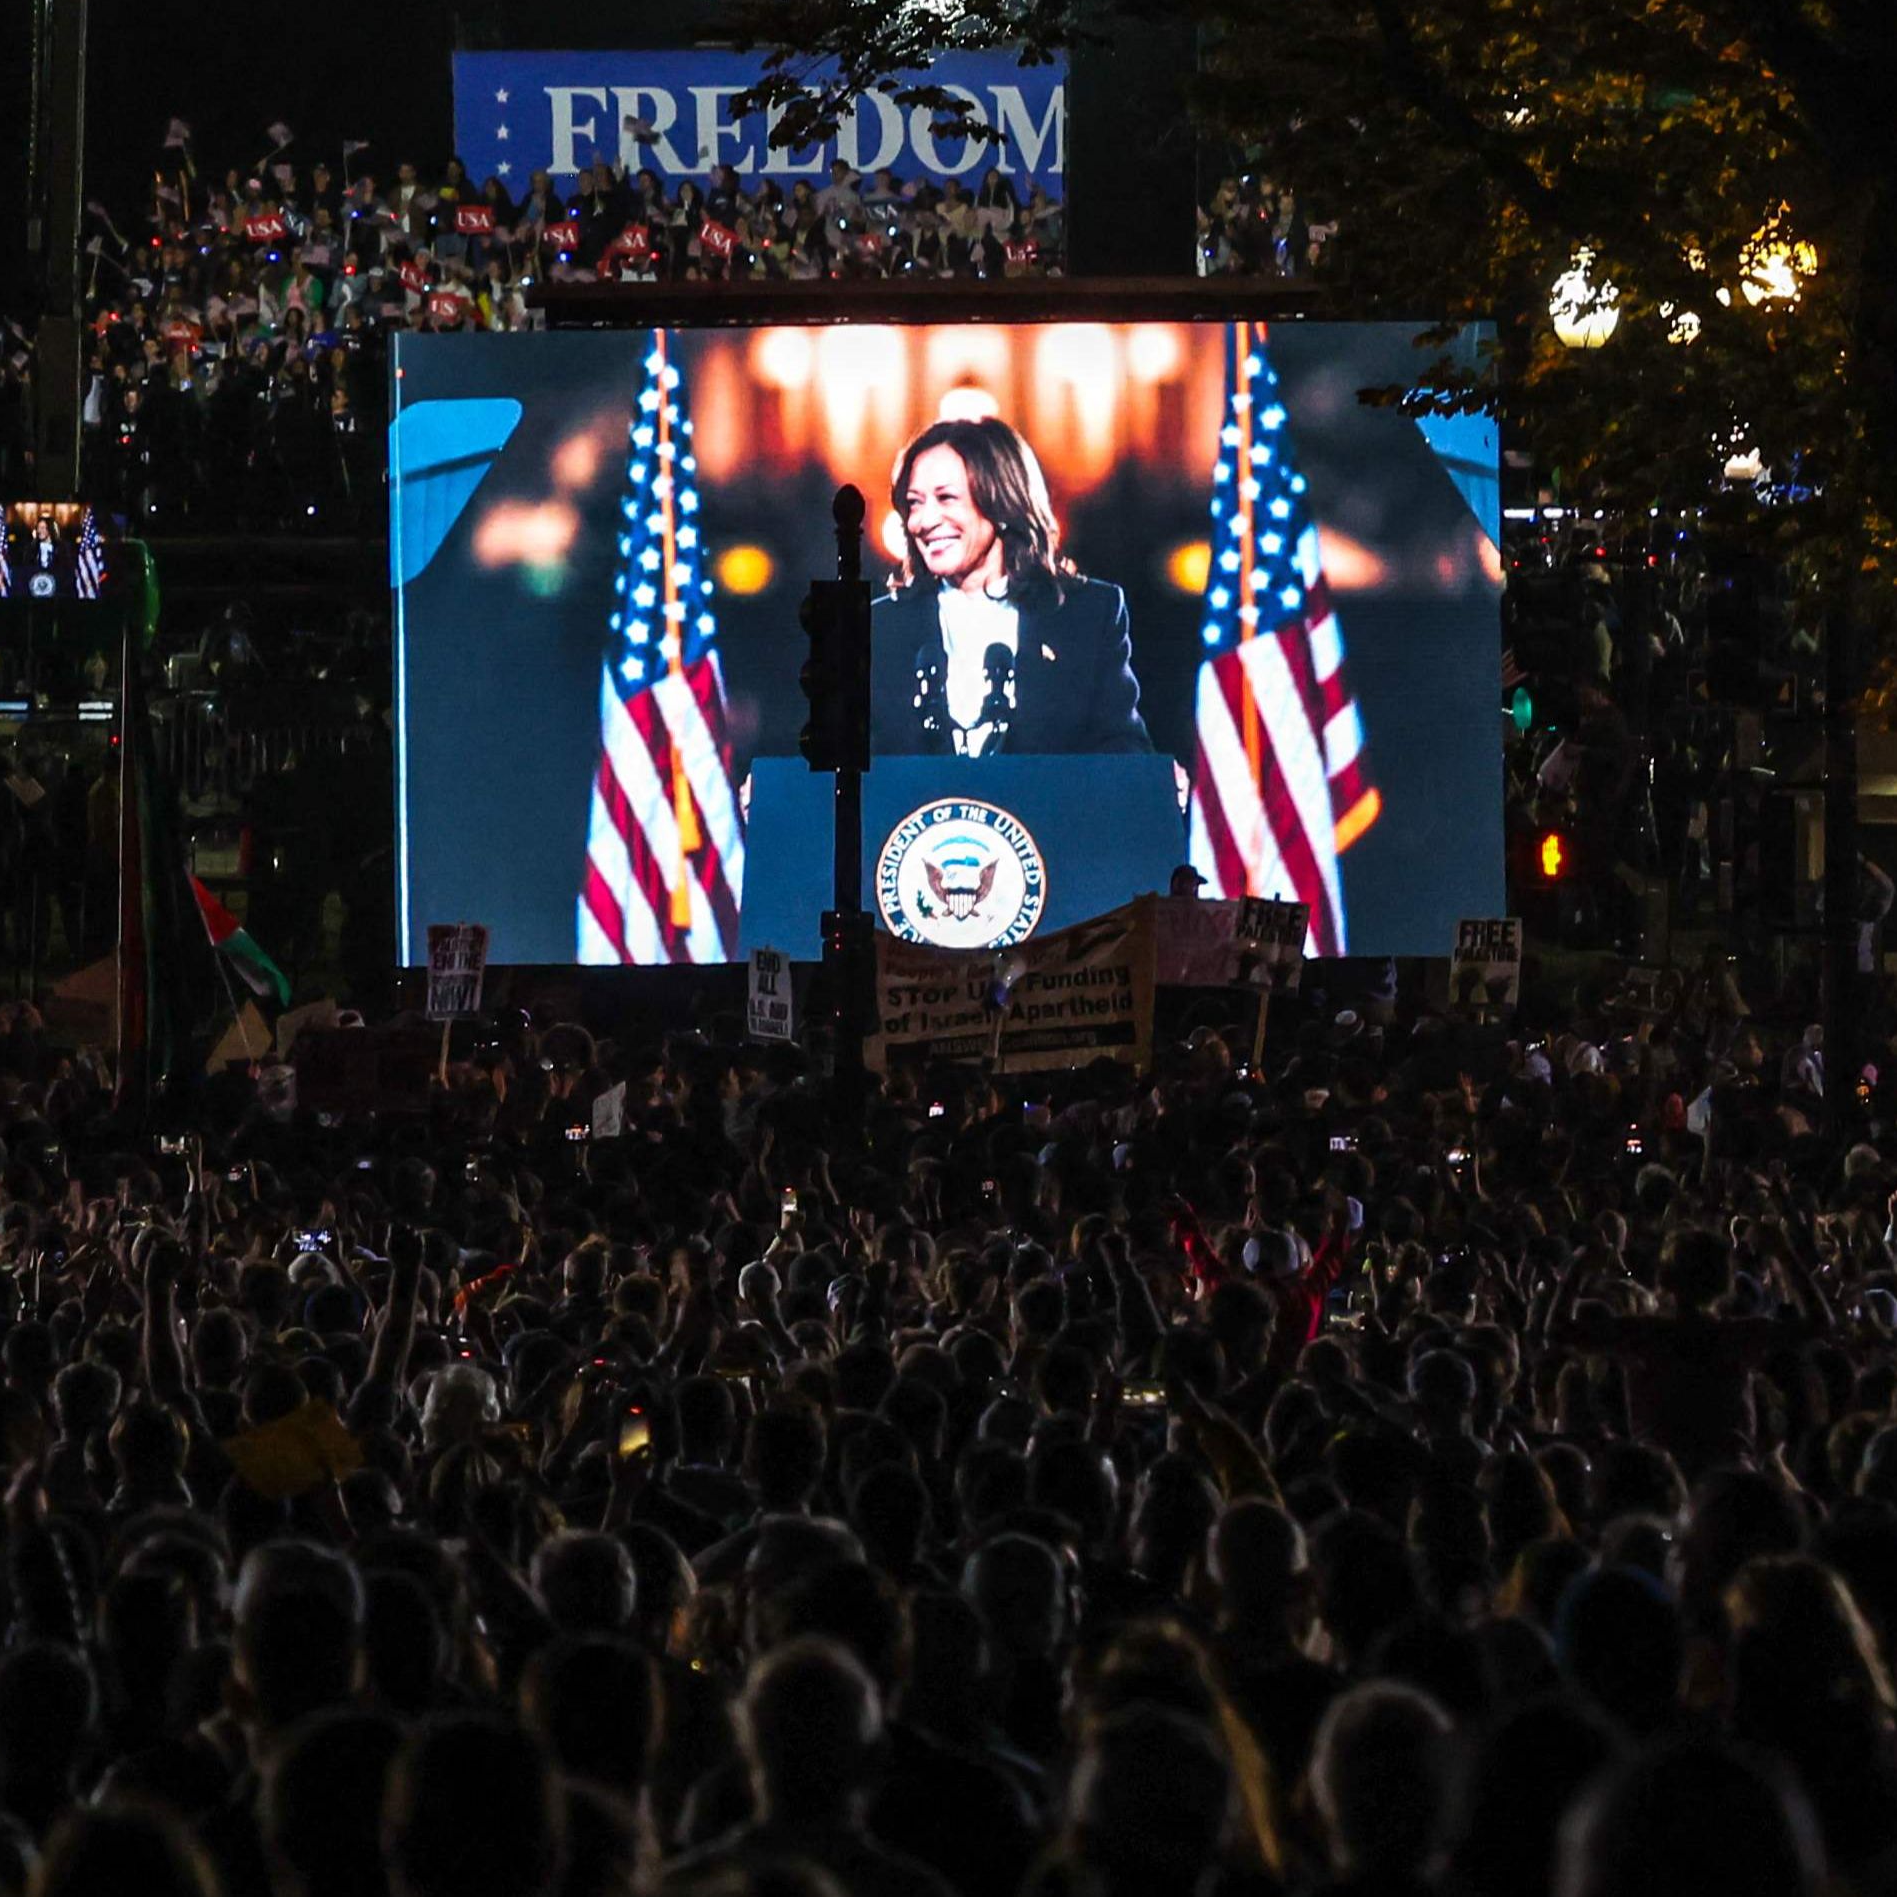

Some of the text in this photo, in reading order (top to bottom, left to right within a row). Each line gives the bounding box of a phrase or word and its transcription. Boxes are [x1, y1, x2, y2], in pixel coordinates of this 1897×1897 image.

[247, 219, 283, 238] USA
[458, 212, 489, 228] USA
[622, 233, 645, 248] SA
[702, 224, 732, 254] USA
[431, 299, 454, 315] US
[880, 813, 929, 914] PRESIDENT
[932, 806, 953, 824] OF
[959, 804, 988, 823] THE
[993, 812, 1040, 884] UNITED
[1459, 921, 1516, 947] FREE
[888, 984, 958, 1006] STOP
[1027, 965, 1131, 993] Funding
[885, 990, 1133, 1033] of Israel Apartheid
